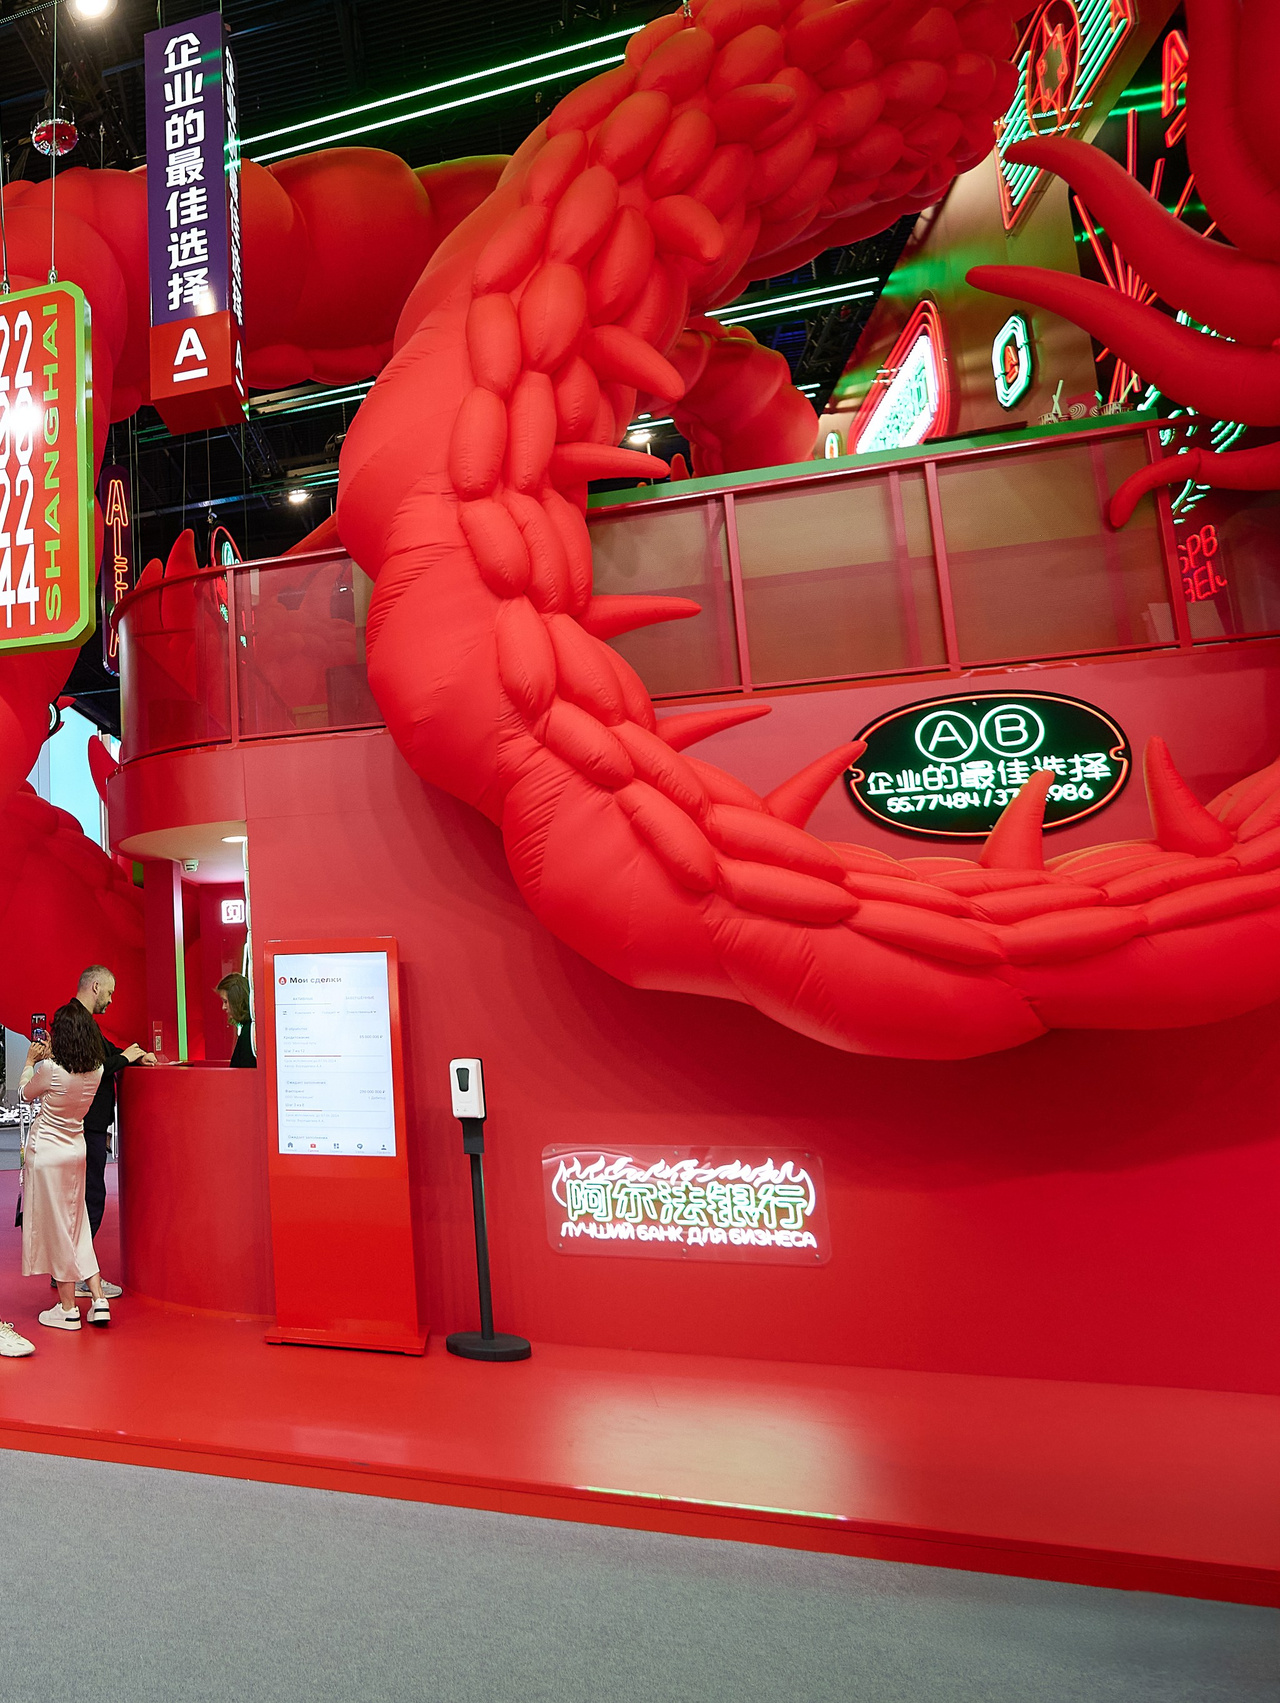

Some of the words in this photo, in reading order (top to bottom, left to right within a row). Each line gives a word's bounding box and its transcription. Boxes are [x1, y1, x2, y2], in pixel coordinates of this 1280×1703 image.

[163, 31, 211, 312] 企业的最佳选择
[41, 302, 62, 621] SHANGHAI
[561, 1222, 635, 1240] ЛУЧШИЙ
[636, 1225, 684, 1243] БАНК
[687, 1226, 728, 1246] ДЛЯ
[729, 1228, 818, 1249] БИЗНЕСА
[565, 1179, 809, 1230] 阿尔法银行
